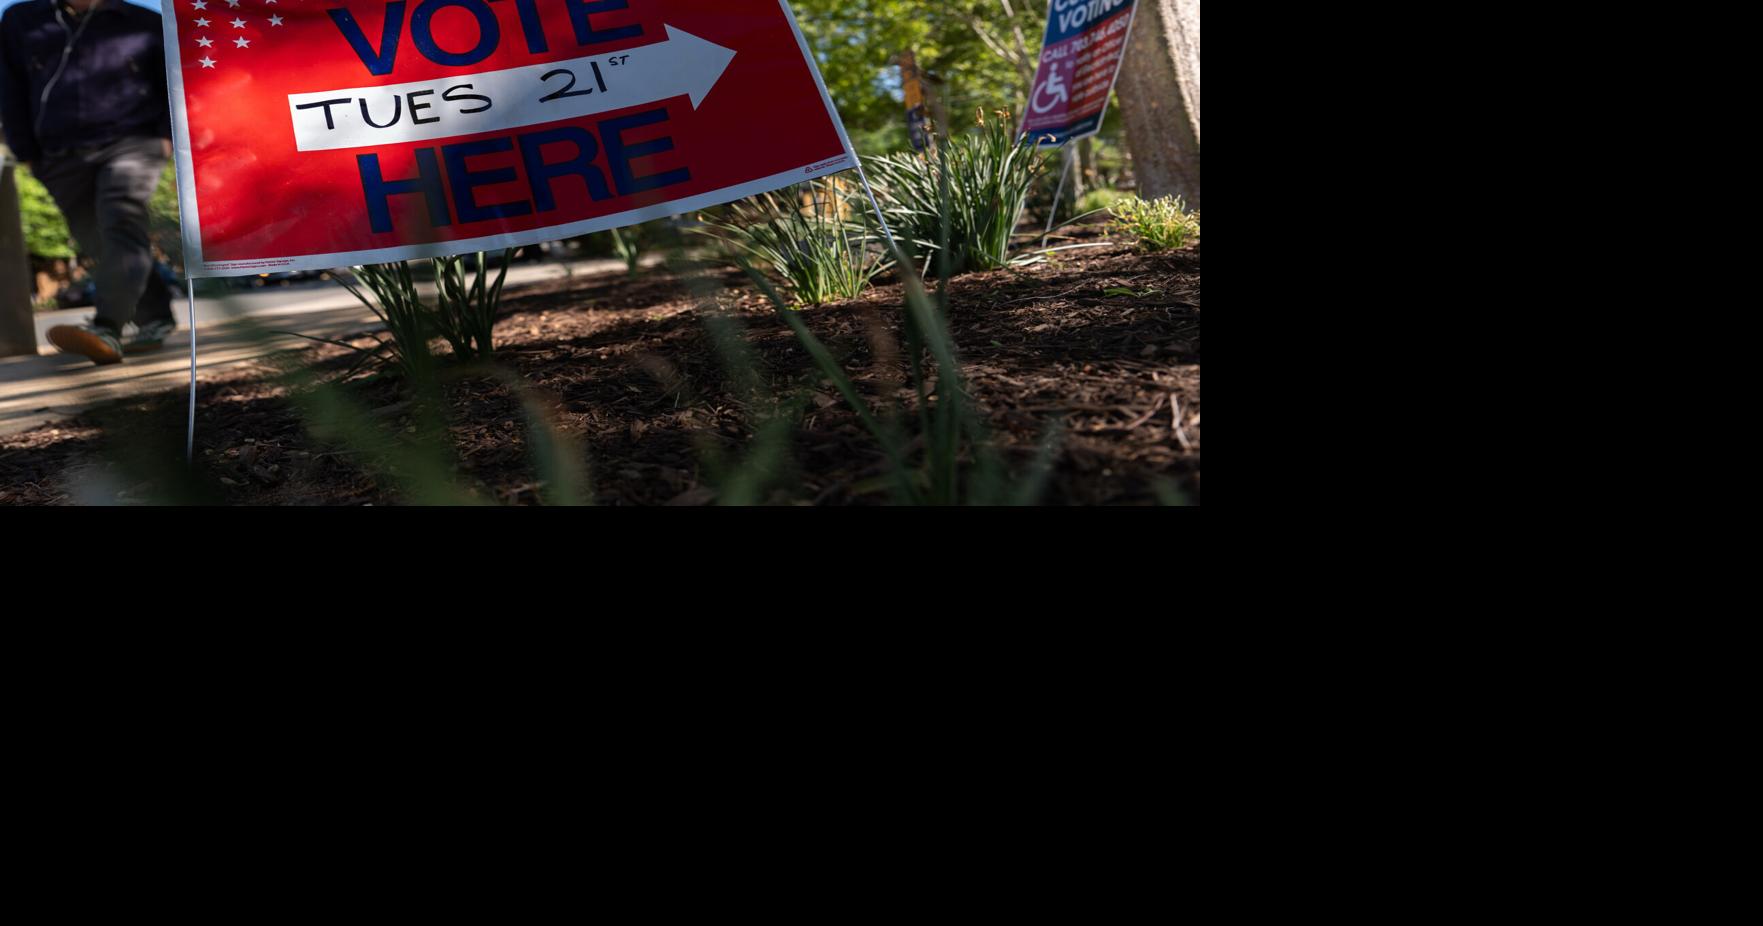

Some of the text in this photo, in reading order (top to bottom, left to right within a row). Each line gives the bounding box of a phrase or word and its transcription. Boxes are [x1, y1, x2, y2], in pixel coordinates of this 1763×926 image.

[326, 0, 644, 76] VOTE
[1042, 45, 1069, 63] CALL
[296, 83, 493, 130] TUES
[356, 107, 691, 234] HERE
